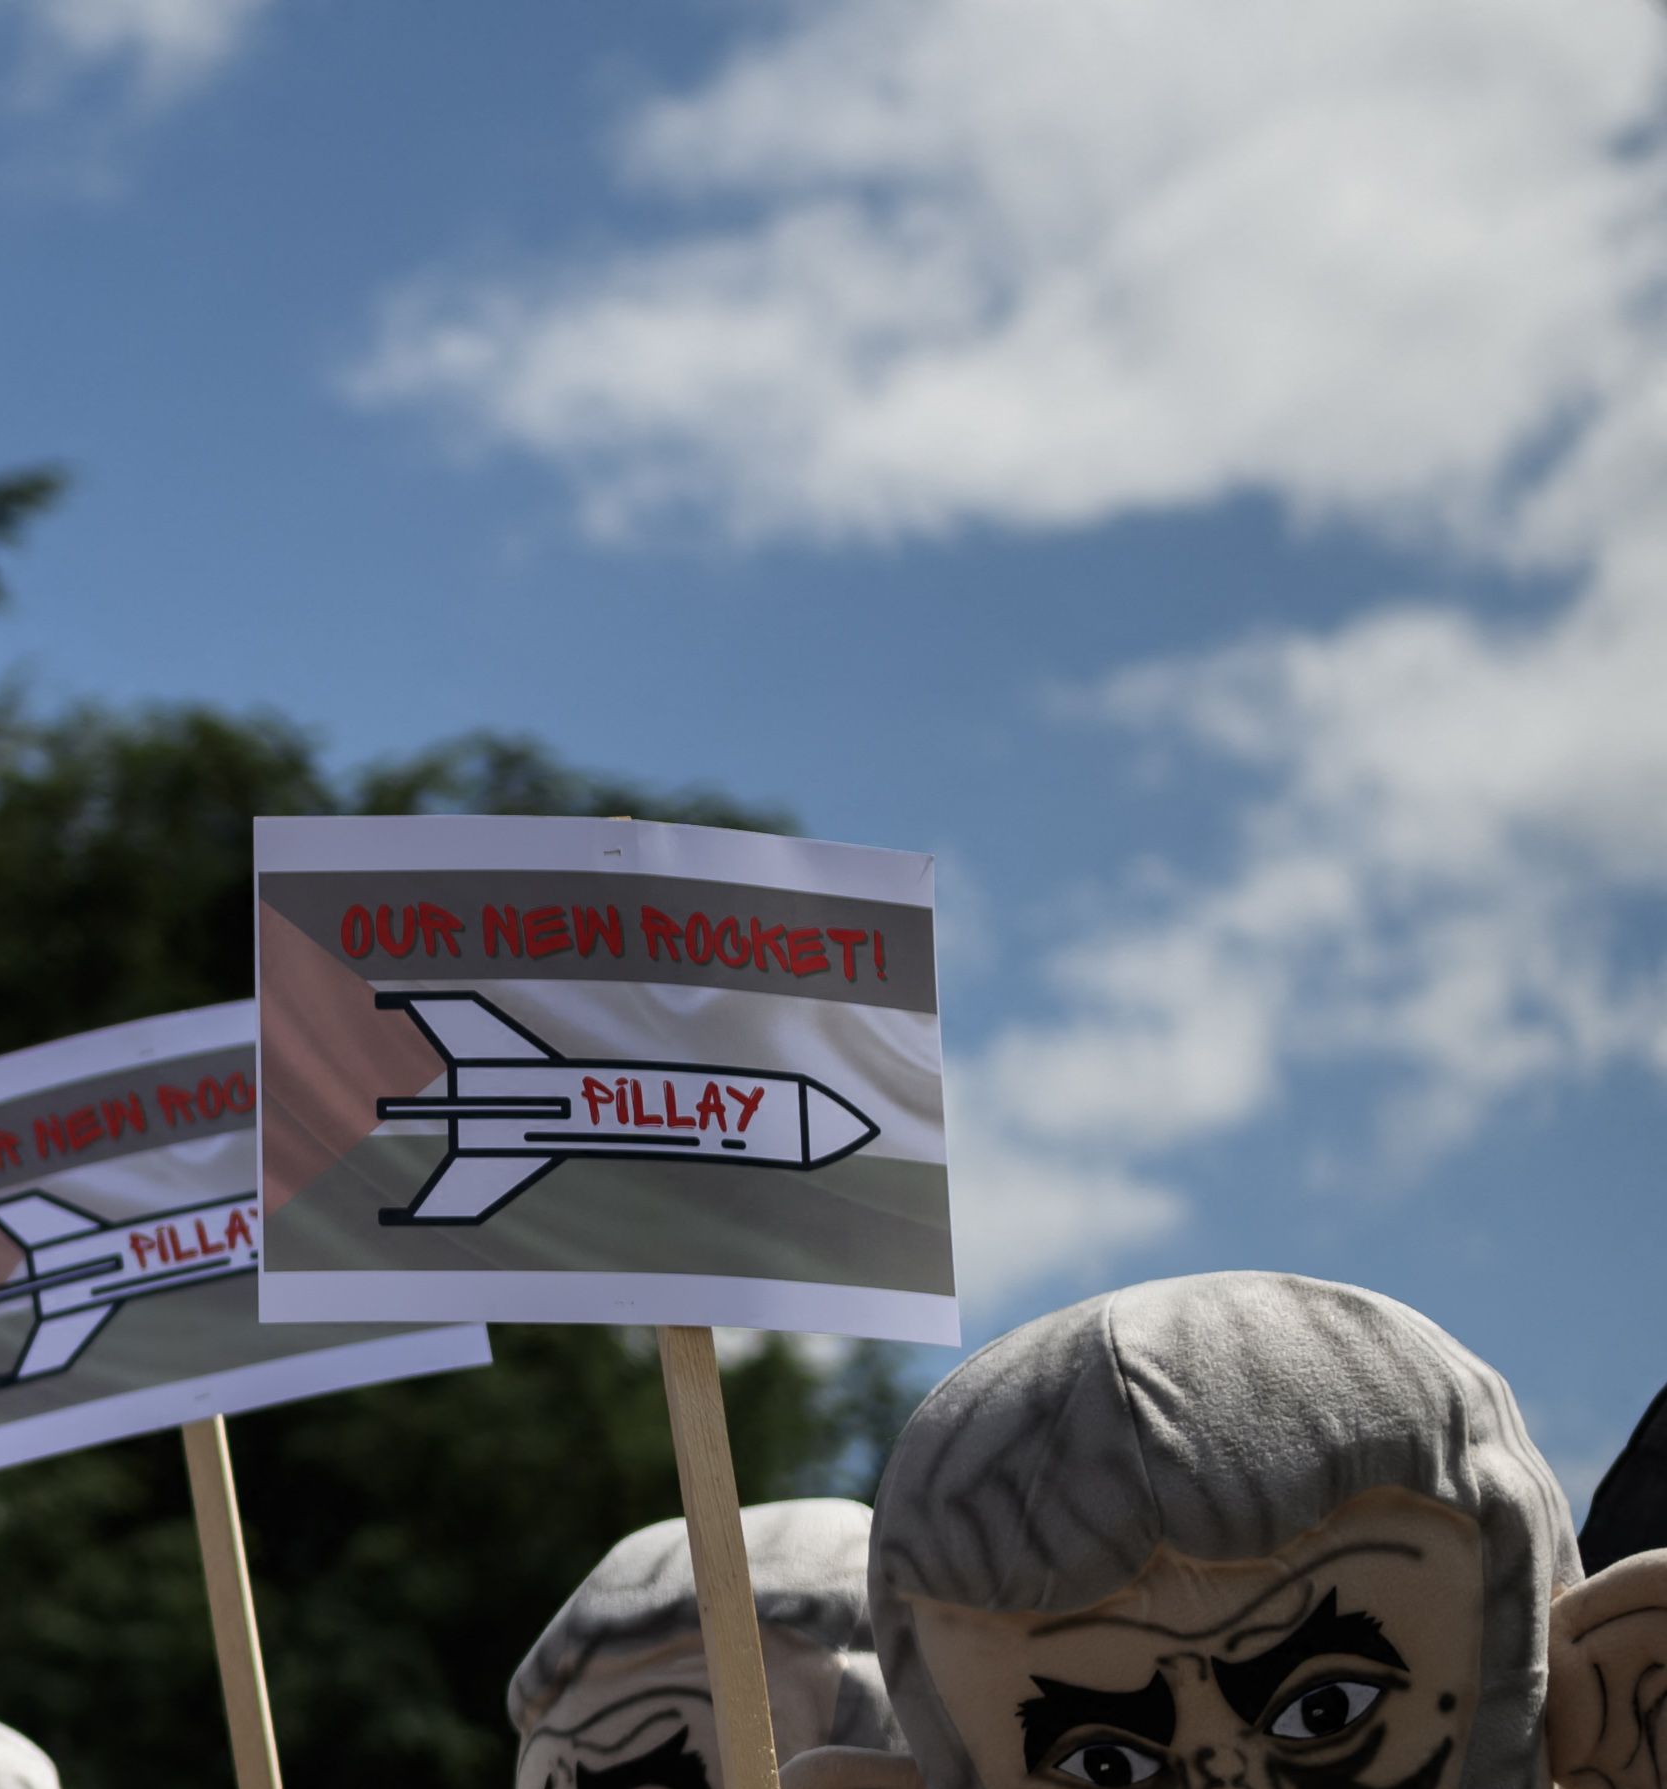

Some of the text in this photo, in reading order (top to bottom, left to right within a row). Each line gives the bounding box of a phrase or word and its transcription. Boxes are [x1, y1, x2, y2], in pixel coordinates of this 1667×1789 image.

[339, 902, 889, 982] OUR NEW ROCKET!
[32, 1090, 149, 1162] NEW
[156, 1070, 257, 1128] ROC
